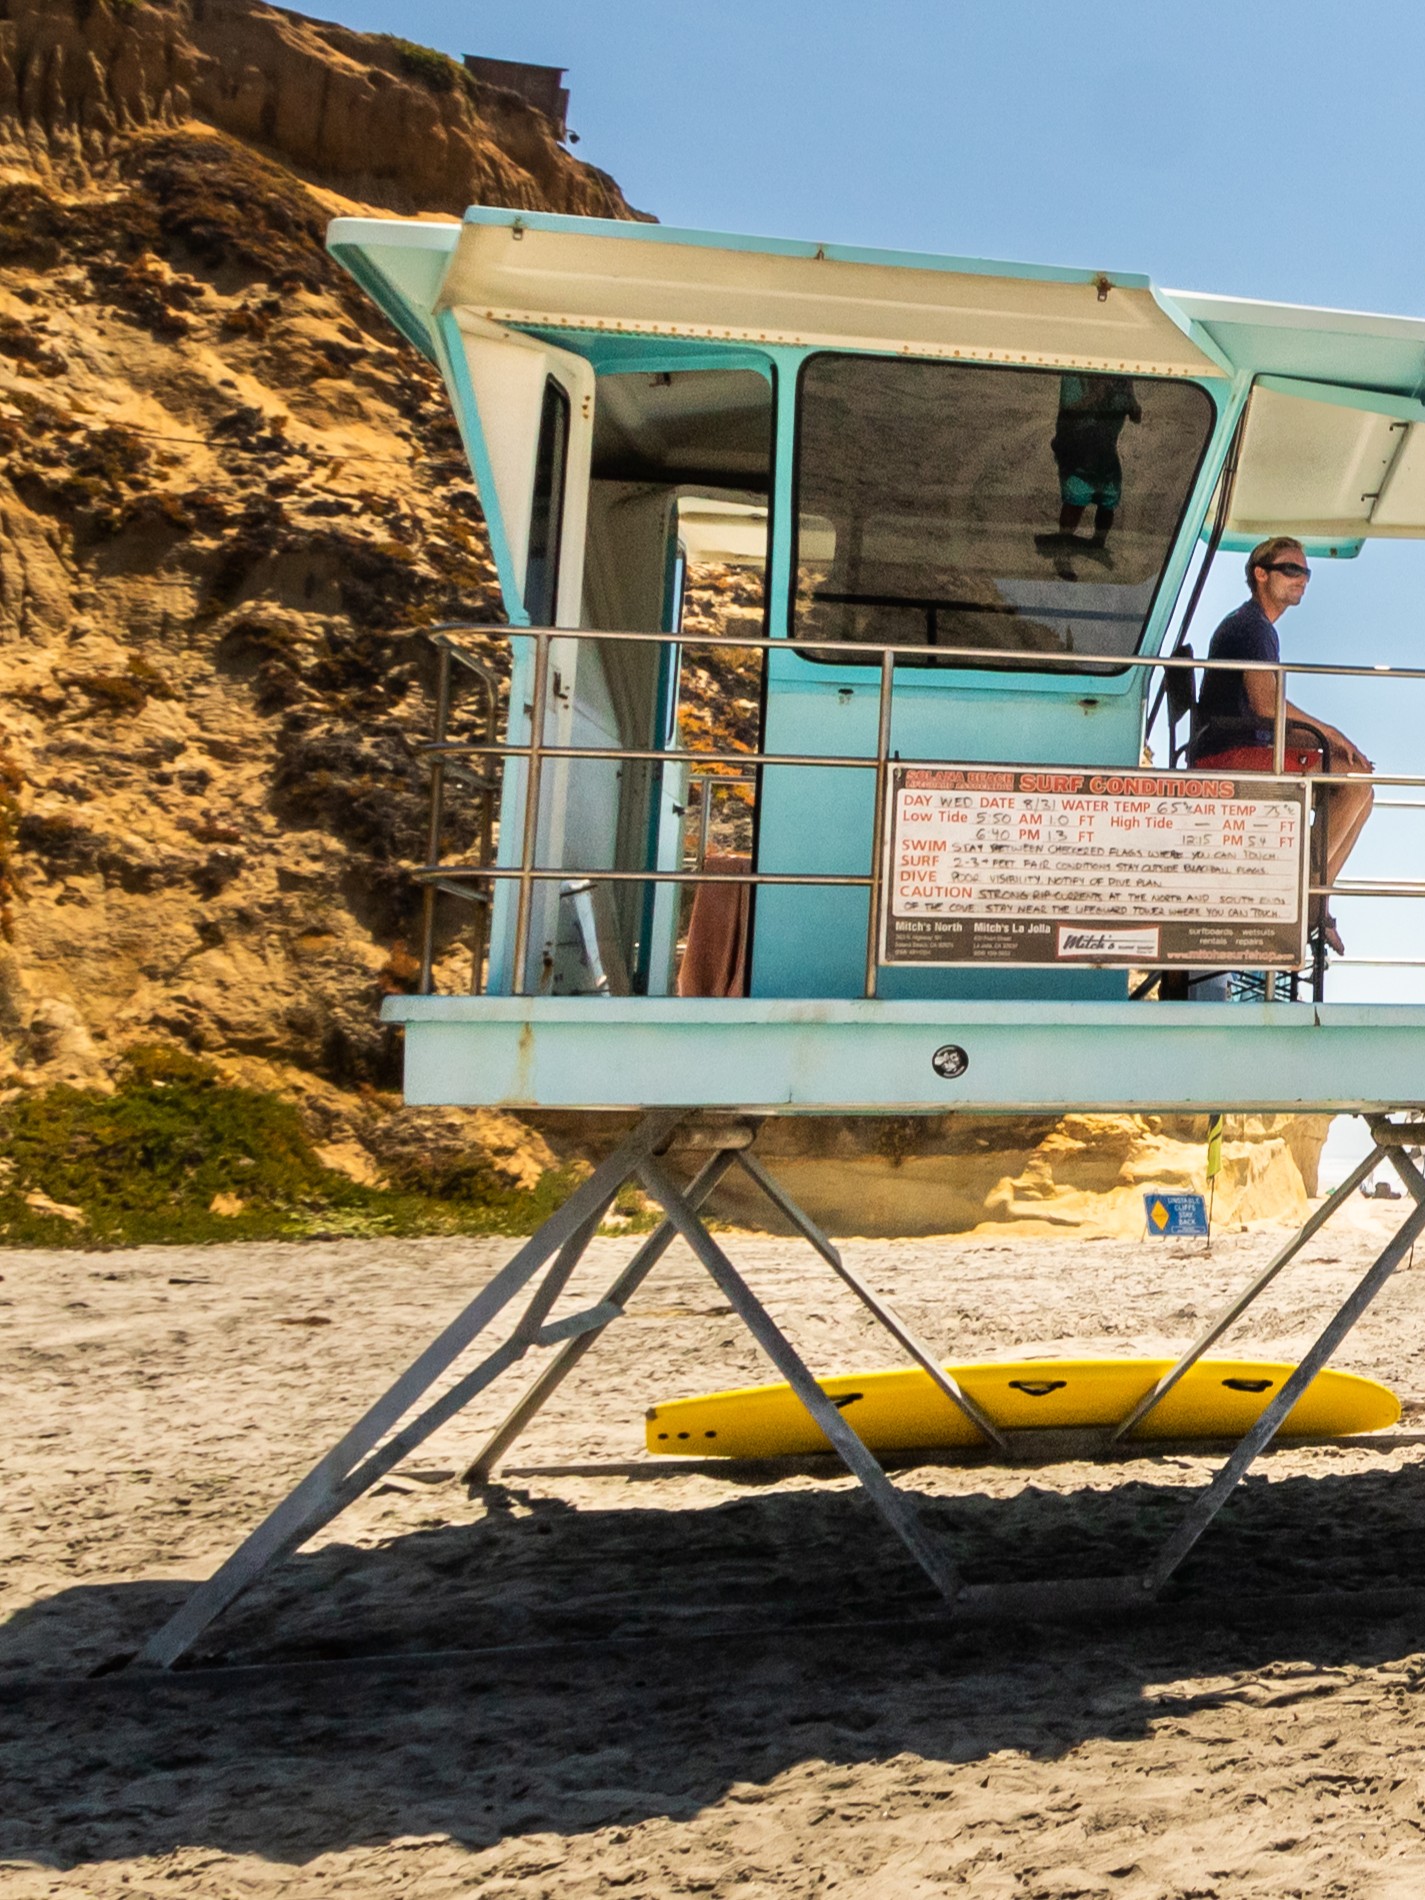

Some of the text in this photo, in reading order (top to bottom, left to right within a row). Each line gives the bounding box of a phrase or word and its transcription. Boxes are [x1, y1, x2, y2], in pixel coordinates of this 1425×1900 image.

[906, 770, 1014, 785] SOLANA BEACH
[1019, 774, 1084, 792] SURF
[1090, 777, 1235, 798] CONDITIONS
[903, 795, 933, 806] DAY
[940, 797, 973, 808] WED
[980, 798, 1015, 809] DATE
[1023, 798, 1056, 812] 8/31
[1062, 799, 1108, 811] WATER
[1114, 801, 1150, 812] TEMP
[1194, 804, 1215, 815] AIR
[1221, 804, 1257, 816] TEMP
[903, 810, 932, 822] Low
[938, 810, 968, 823] Tide
[1019, 814, 1042, 824] AM
[1079, 815, 1096, 826] FT
[1111, 817, 1140, 830] High
[1145, 817, 1173, 829] Tide
[1222, 819, 1245, 831] AM
[1280, 821, 1296, 832] FT
[1019, 829, 1040, 840] PM
[1078, 831, 1095, 842] FT
[1223, 835, 1244, 846] PM
[1280, 837, 1296, 847] FT
[902, 840, 947, 852] SWIM
[952, 843, 983, 853] STAY
[1214, 851, 1237, 860] CAN
[901, 855, 940, 867] SURF
[1024, 859, 1049, 869] FAIR
[1116, 862, 1139, 872] STAY
[900, 870, 937, 882] DIVE
[1048, 876, 1085, 886] NOTIFY
[1089, 876, 1103, 885] OF
[1108, 877, 1130, 886] DIVE
[899, 886, 973, 898] CAUTION
[978, 889, 1028, 900] STRONG
[1109, 892, 1121, 901] AT
[1128, 893, 1146, 902] THE
[1151, 894, 1182, 903] NORTH
[1186, 894, 1210, 903] AND
[1219, 896, 1255, 905] SOUTH
[903, 901, 919, 911] OF
[924, 902, 944, 911] THE
[985, 904, 1014, 914] STAY
[1017, 905, 1047, 914] NEAR
[1052, 905, 1070, 914] THE
[1133, 906, 1166, 916] TOWER
[1168, 907, 1201, 917] WHERE
[1205, 908, 1225, 917] YOU
[1228, 908, 1249, 917] CAN
[895, 921, 963, 932] Mitch's North
[974, 922, 1051, 934] Mitch's La Jolla
[1188, 927, 1276, 937] surfboards wetsuits
[1063, 934, 1115, 950] Mitch's
[1199, 938, 1264, 947] rentals repairs
[1174, 1204, 1196, 1212] CLIFFS
